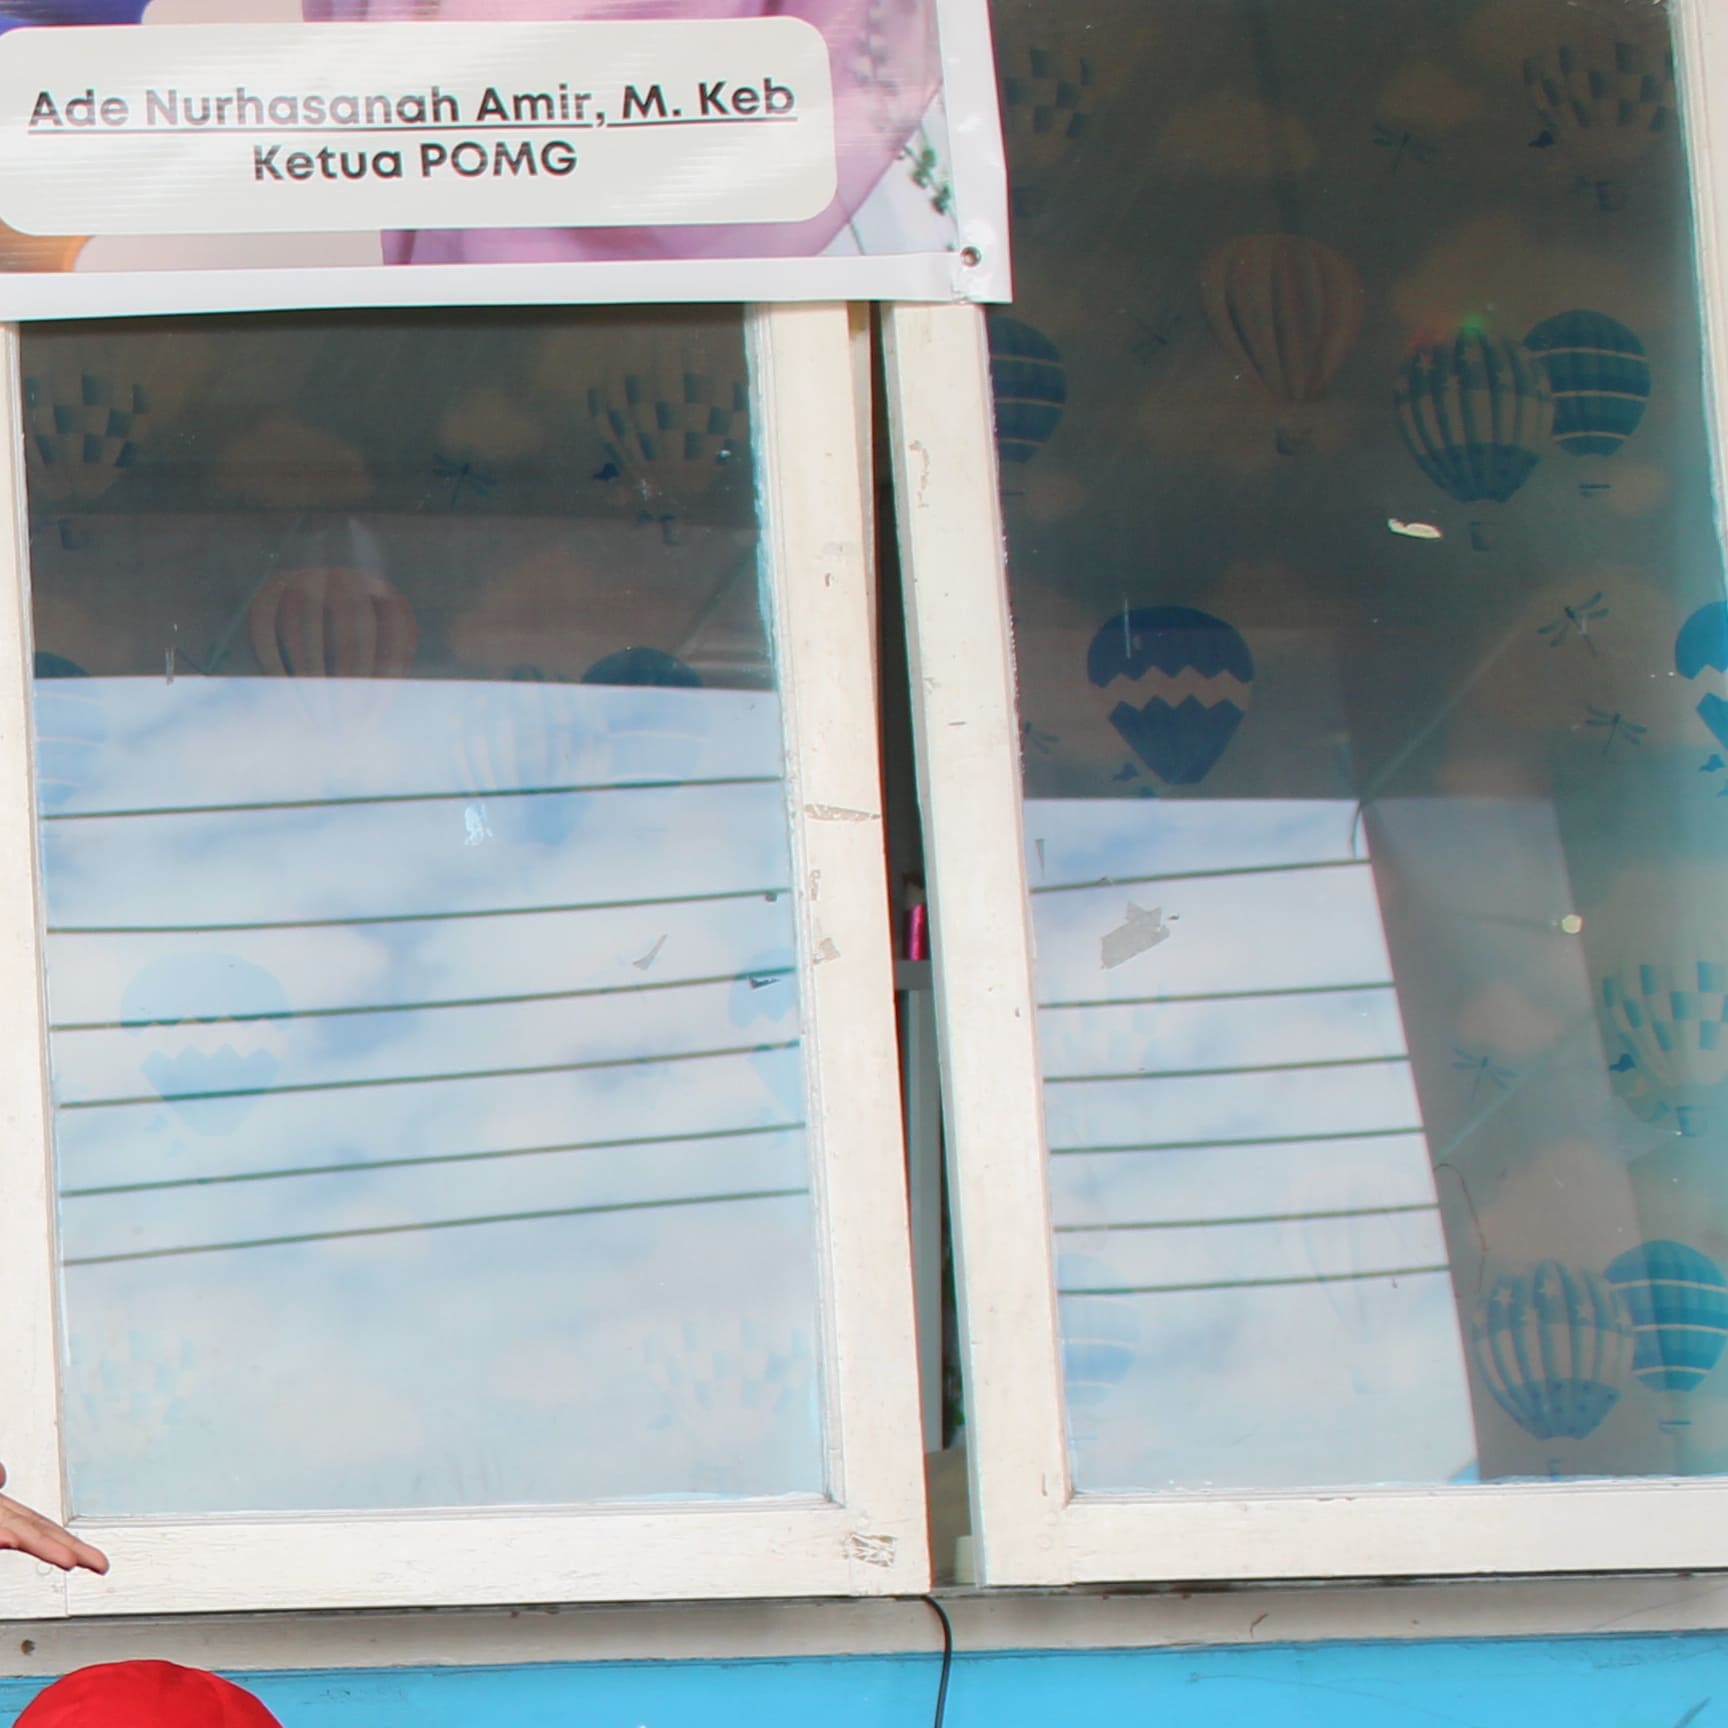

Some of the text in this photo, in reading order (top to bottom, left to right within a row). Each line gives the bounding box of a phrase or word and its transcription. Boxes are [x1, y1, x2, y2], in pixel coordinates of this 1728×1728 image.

[28, 79, 797, 130] Ade Nurhasanah Amir, M. Keb
[252, 140, 578, 182] Ketua POMG
